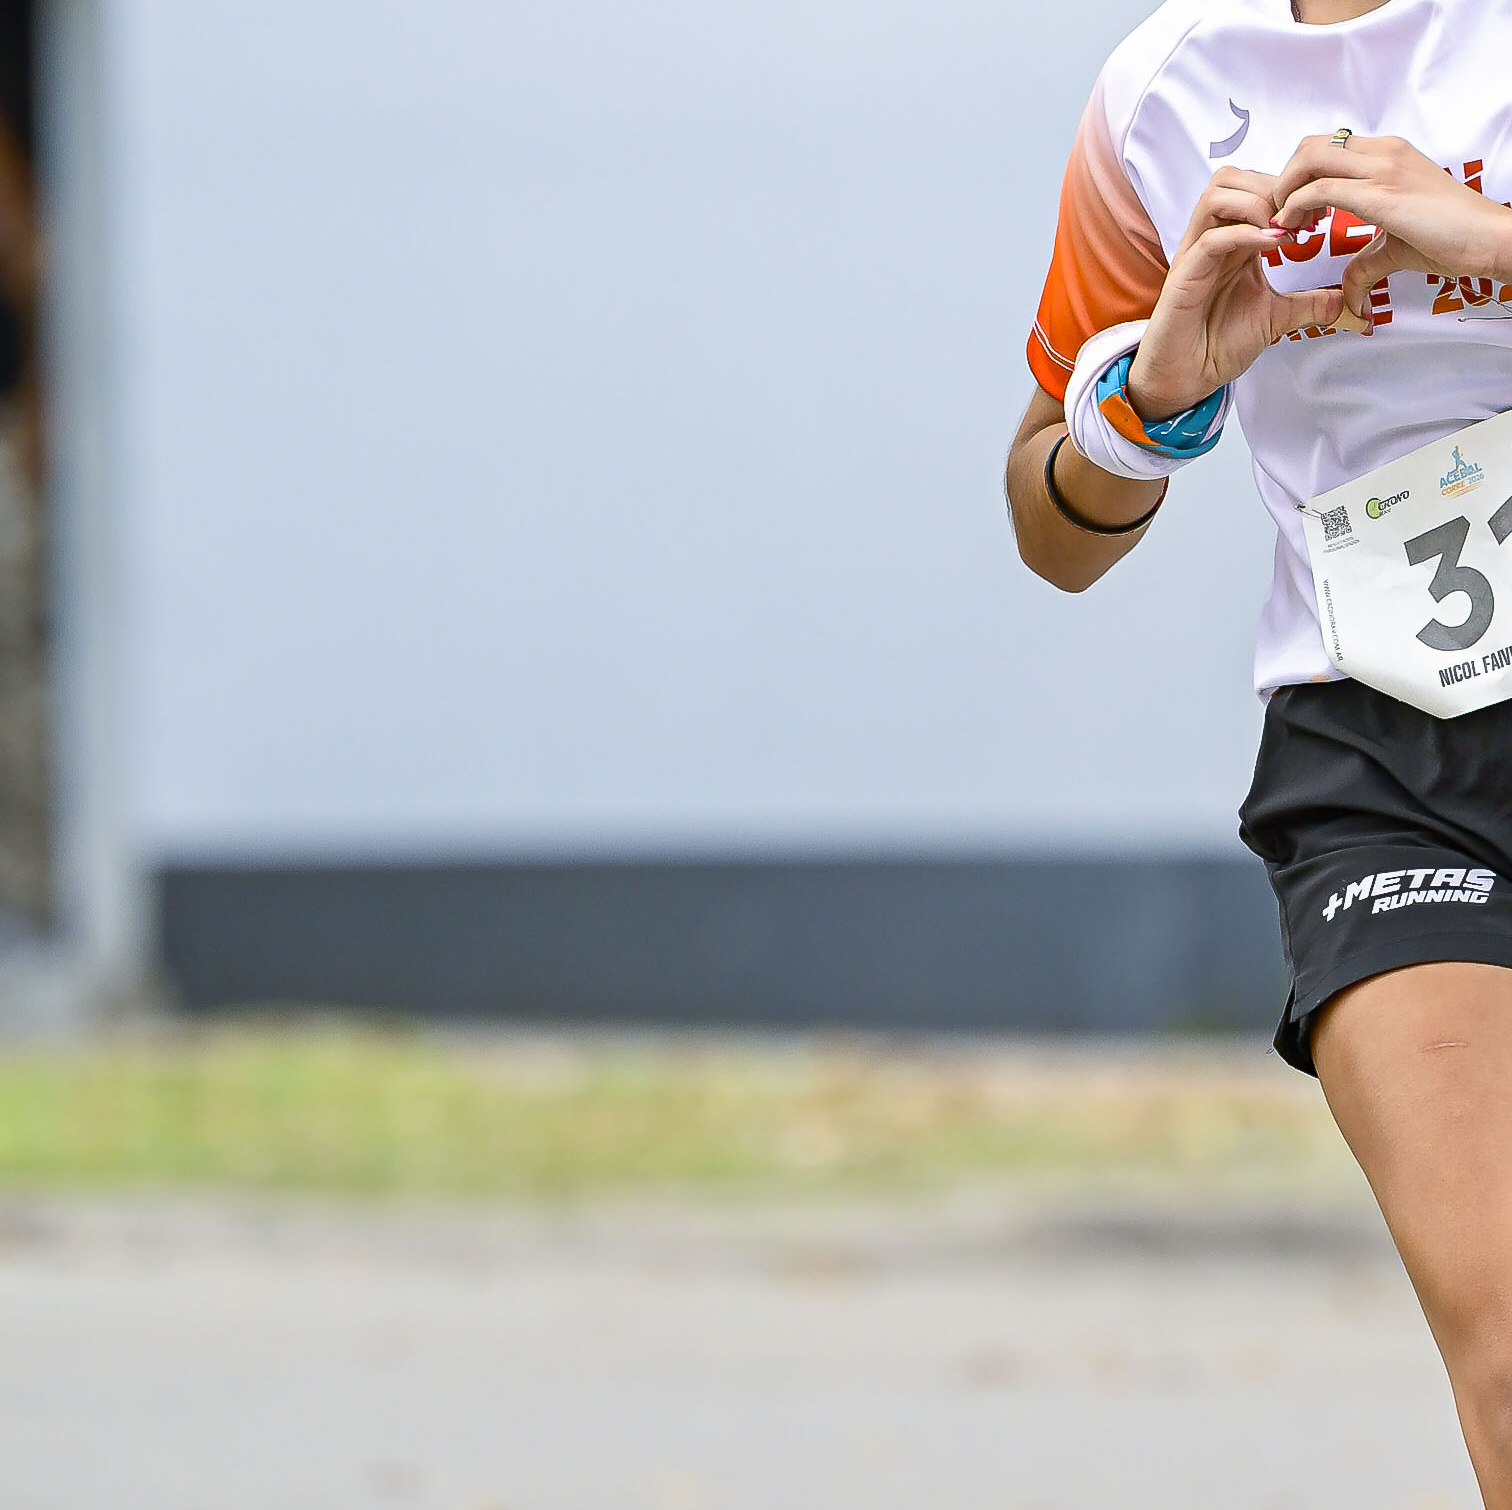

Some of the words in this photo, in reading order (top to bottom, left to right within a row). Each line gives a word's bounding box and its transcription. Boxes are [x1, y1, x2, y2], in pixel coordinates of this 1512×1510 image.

[1440, 462, 1483, 489] ACEBAL
[1438, 660, 1481, 688] NICOL
[1371, 889, 1490, 915] RUNNING
